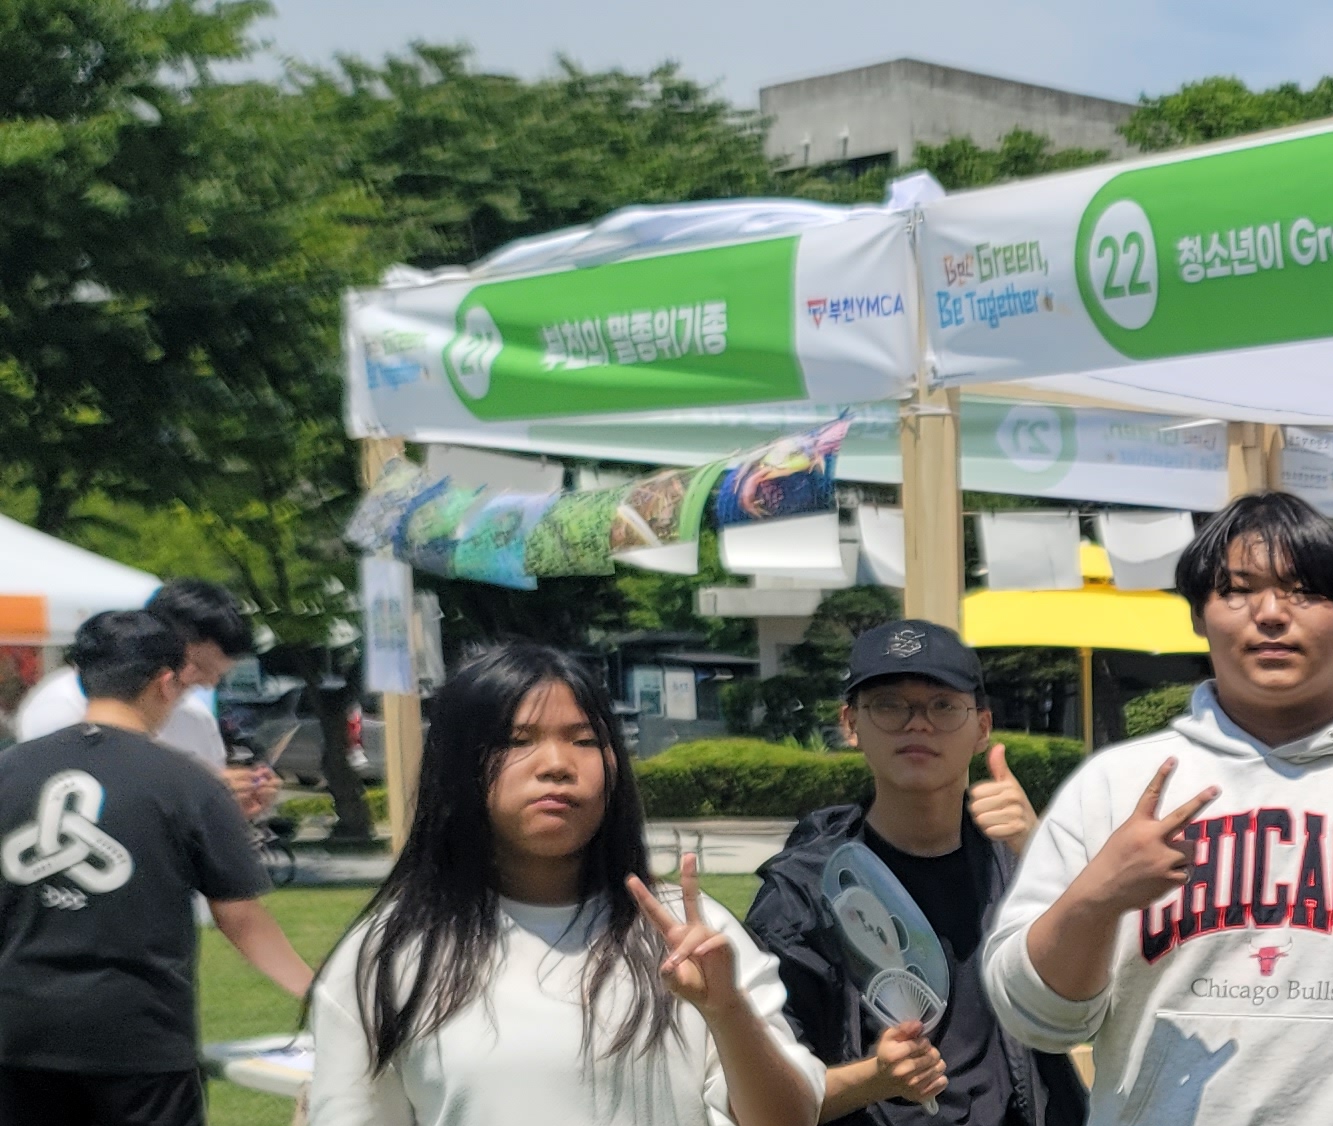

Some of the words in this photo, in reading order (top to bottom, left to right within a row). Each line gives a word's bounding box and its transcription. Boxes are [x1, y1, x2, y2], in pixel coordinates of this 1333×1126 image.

[977, 238, 1049, 283] Green,
[1099, 231, 1152, 300] 22
[1176, 222, 1285, 283] 청소년이
[828, 294, 905, 322] 부천YMCA
[937, 290, 963, 329] Be
[964, 283, 1040, 328] Together
[606, 301, 728, 366] 멸종위기종
[1191, 977, 1279, 1005] Chicago
